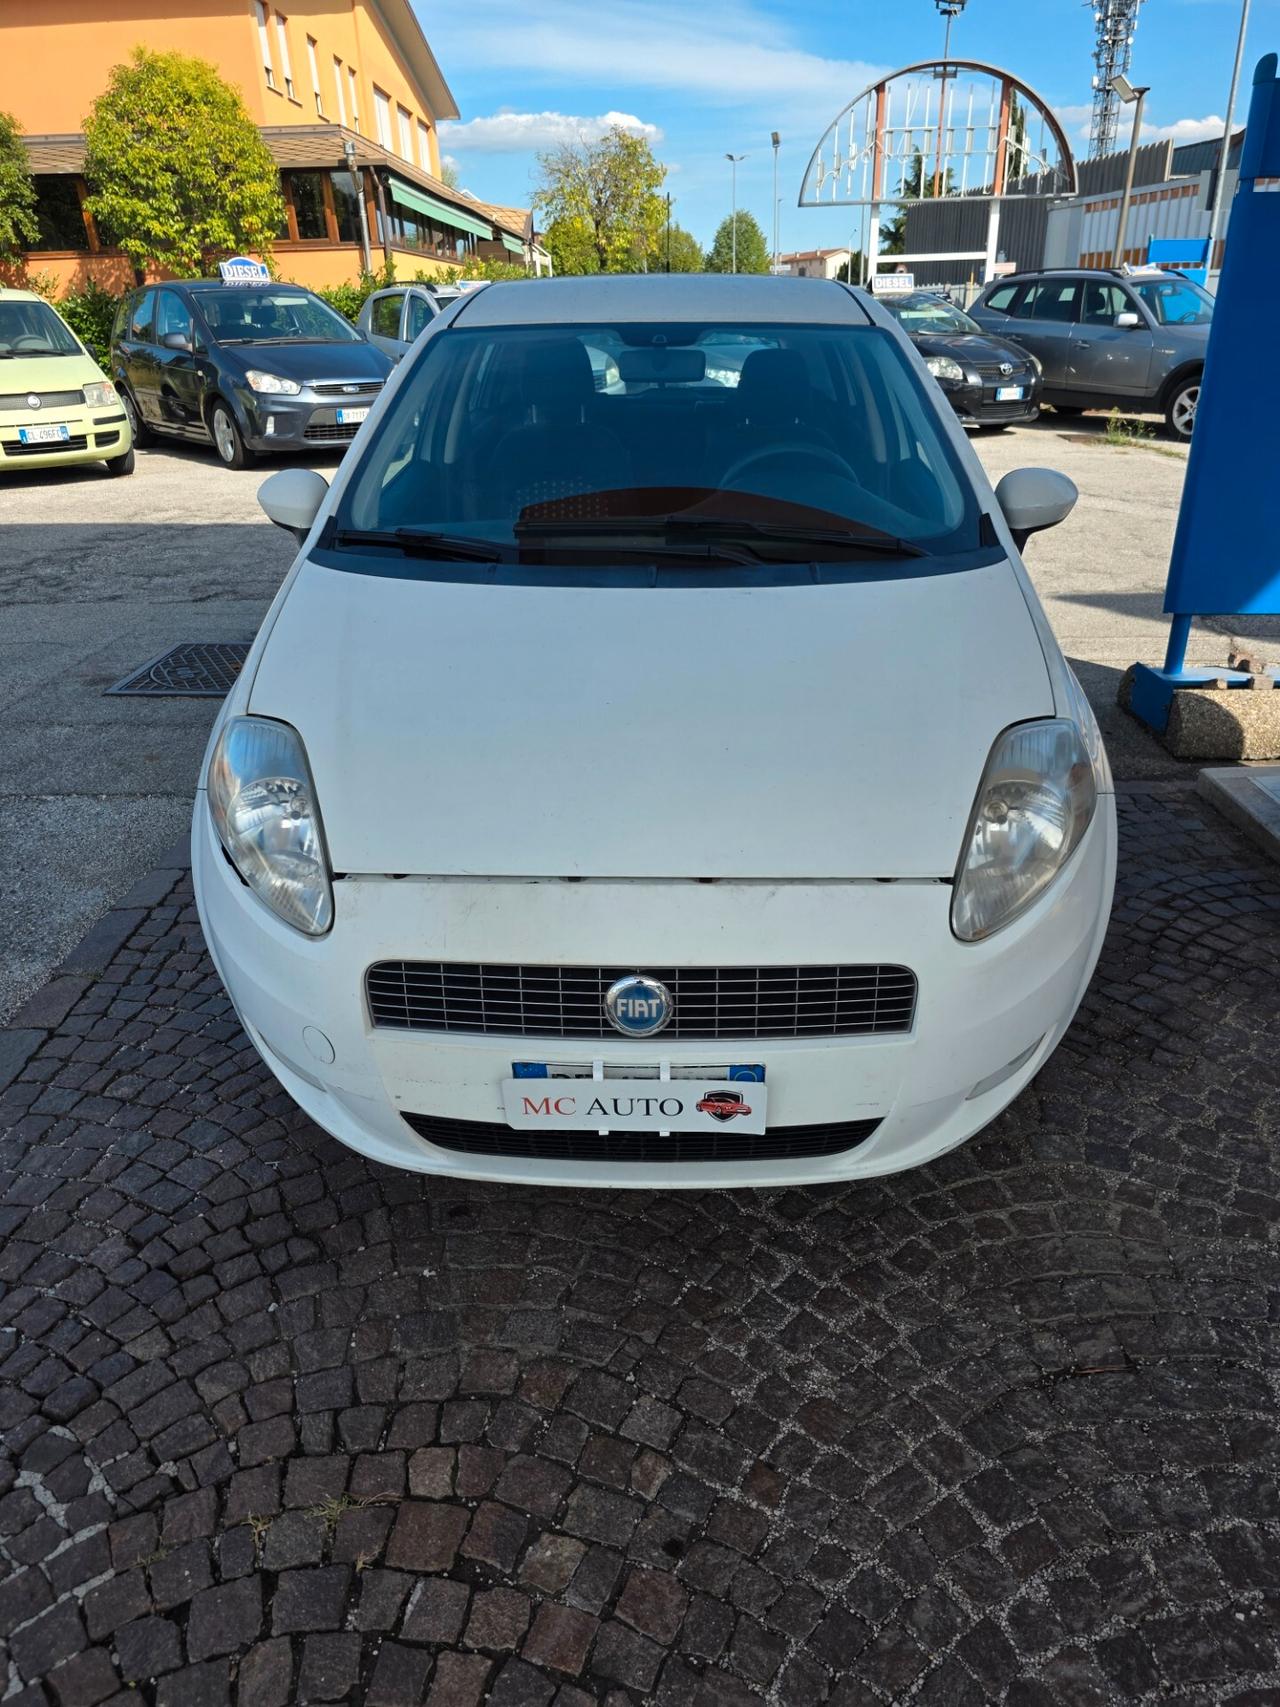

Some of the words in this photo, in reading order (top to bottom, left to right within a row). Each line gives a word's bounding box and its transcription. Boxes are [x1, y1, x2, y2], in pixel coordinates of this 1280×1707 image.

[224, 265, 267, 278] DIESEL
[875, 277, 912, 288] DIESEL
[617, 998, 660, 1018] FIAT
[521, 1096, 576, 1116] MC
[586, 1097, 684, 1117] AUTO
